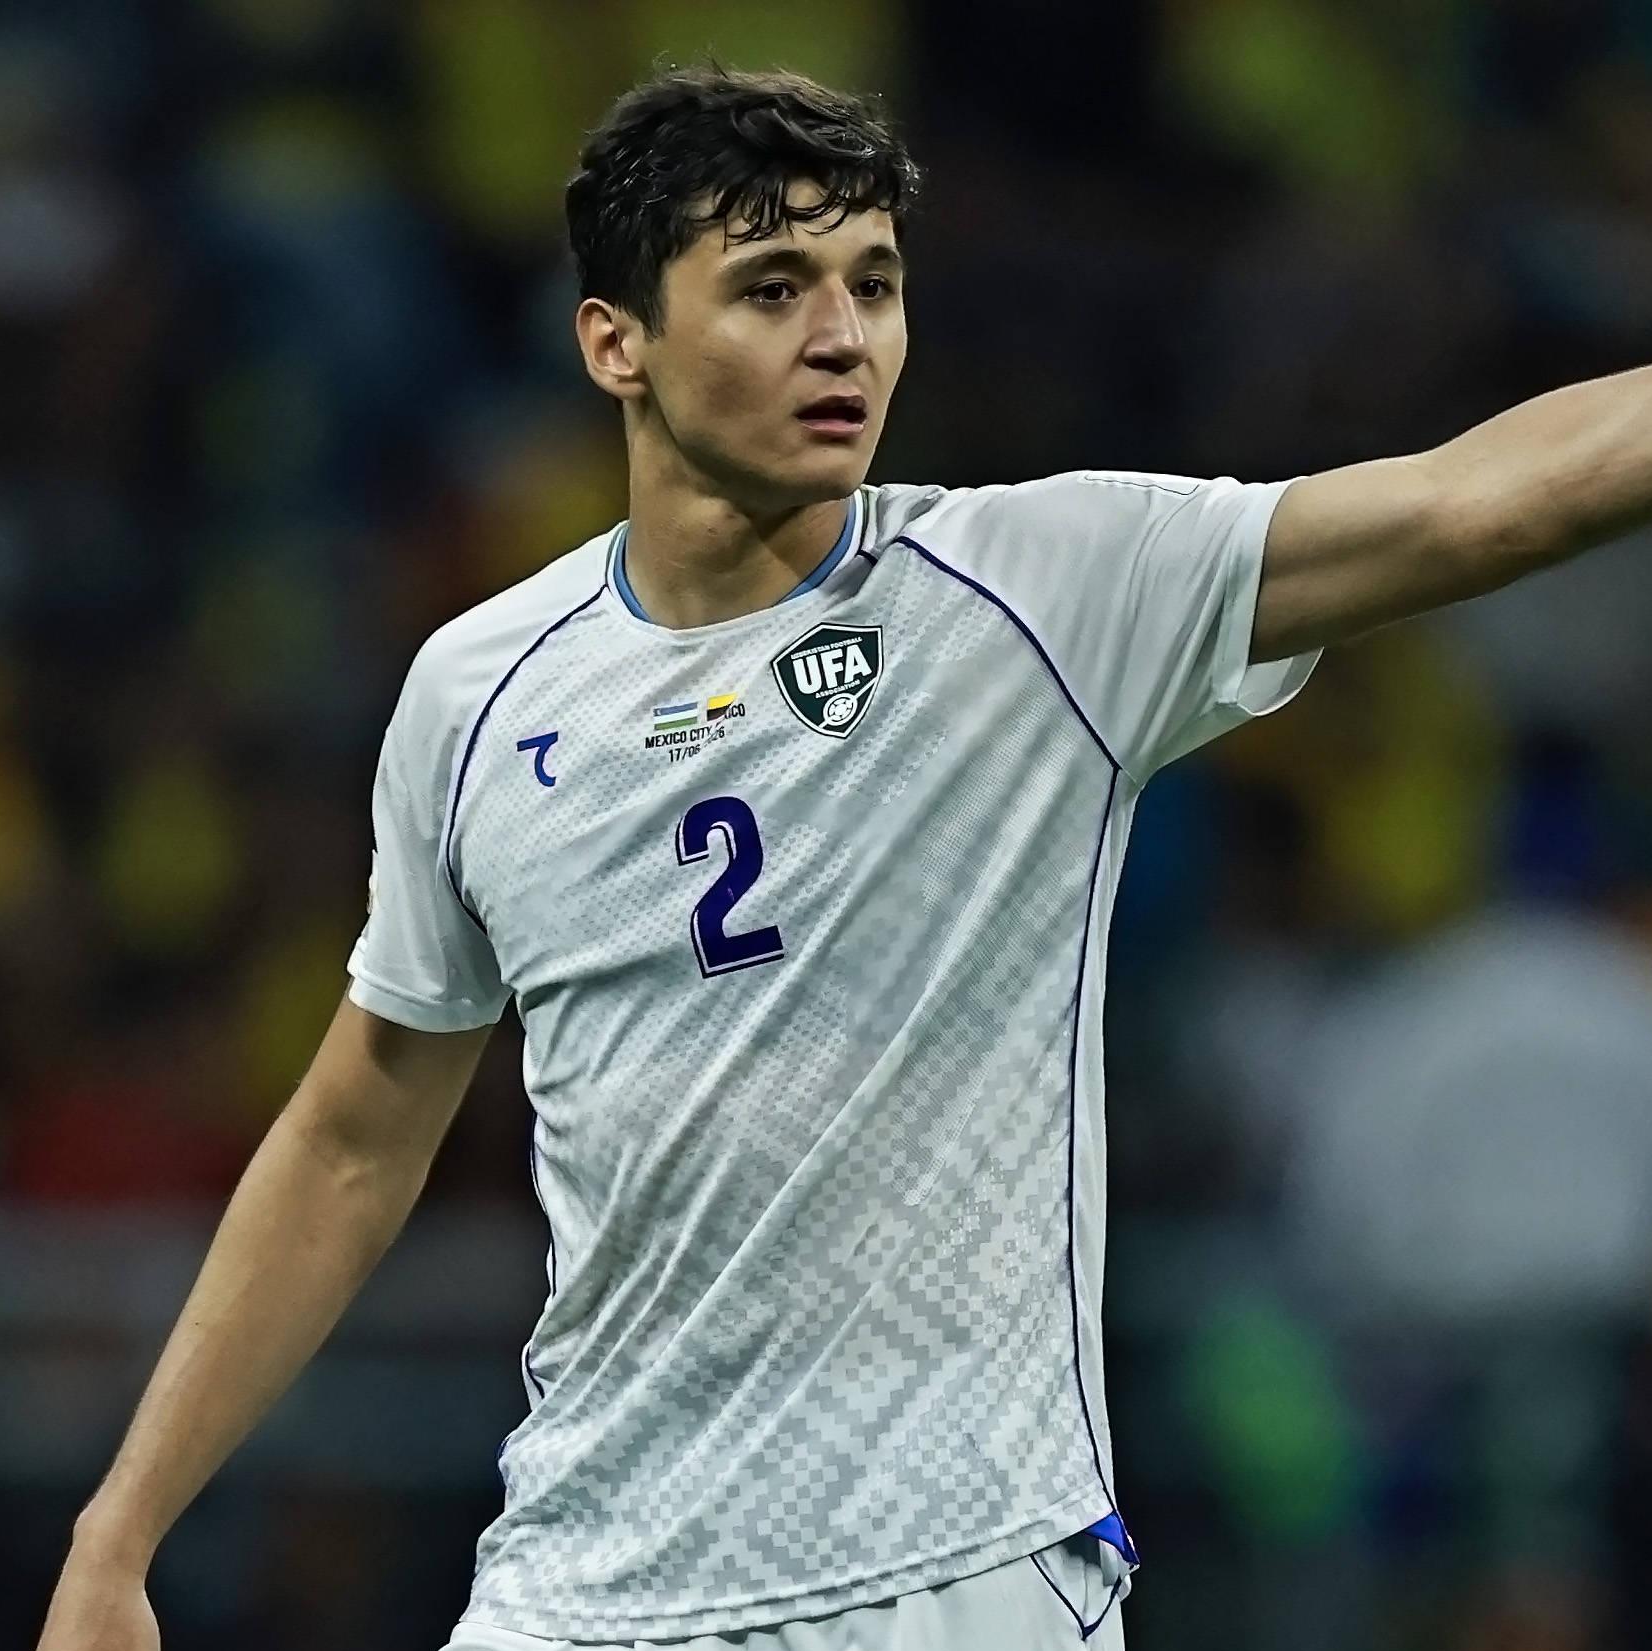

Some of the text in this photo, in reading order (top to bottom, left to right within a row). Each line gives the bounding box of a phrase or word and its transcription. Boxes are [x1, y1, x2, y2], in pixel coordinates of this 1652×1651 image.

[793, 645, 872, 694] UFA
[645, 730, 687, 749] MEXICO
[690, 726, 713, 743] CITY
[675, 796, 785, 979] 2
